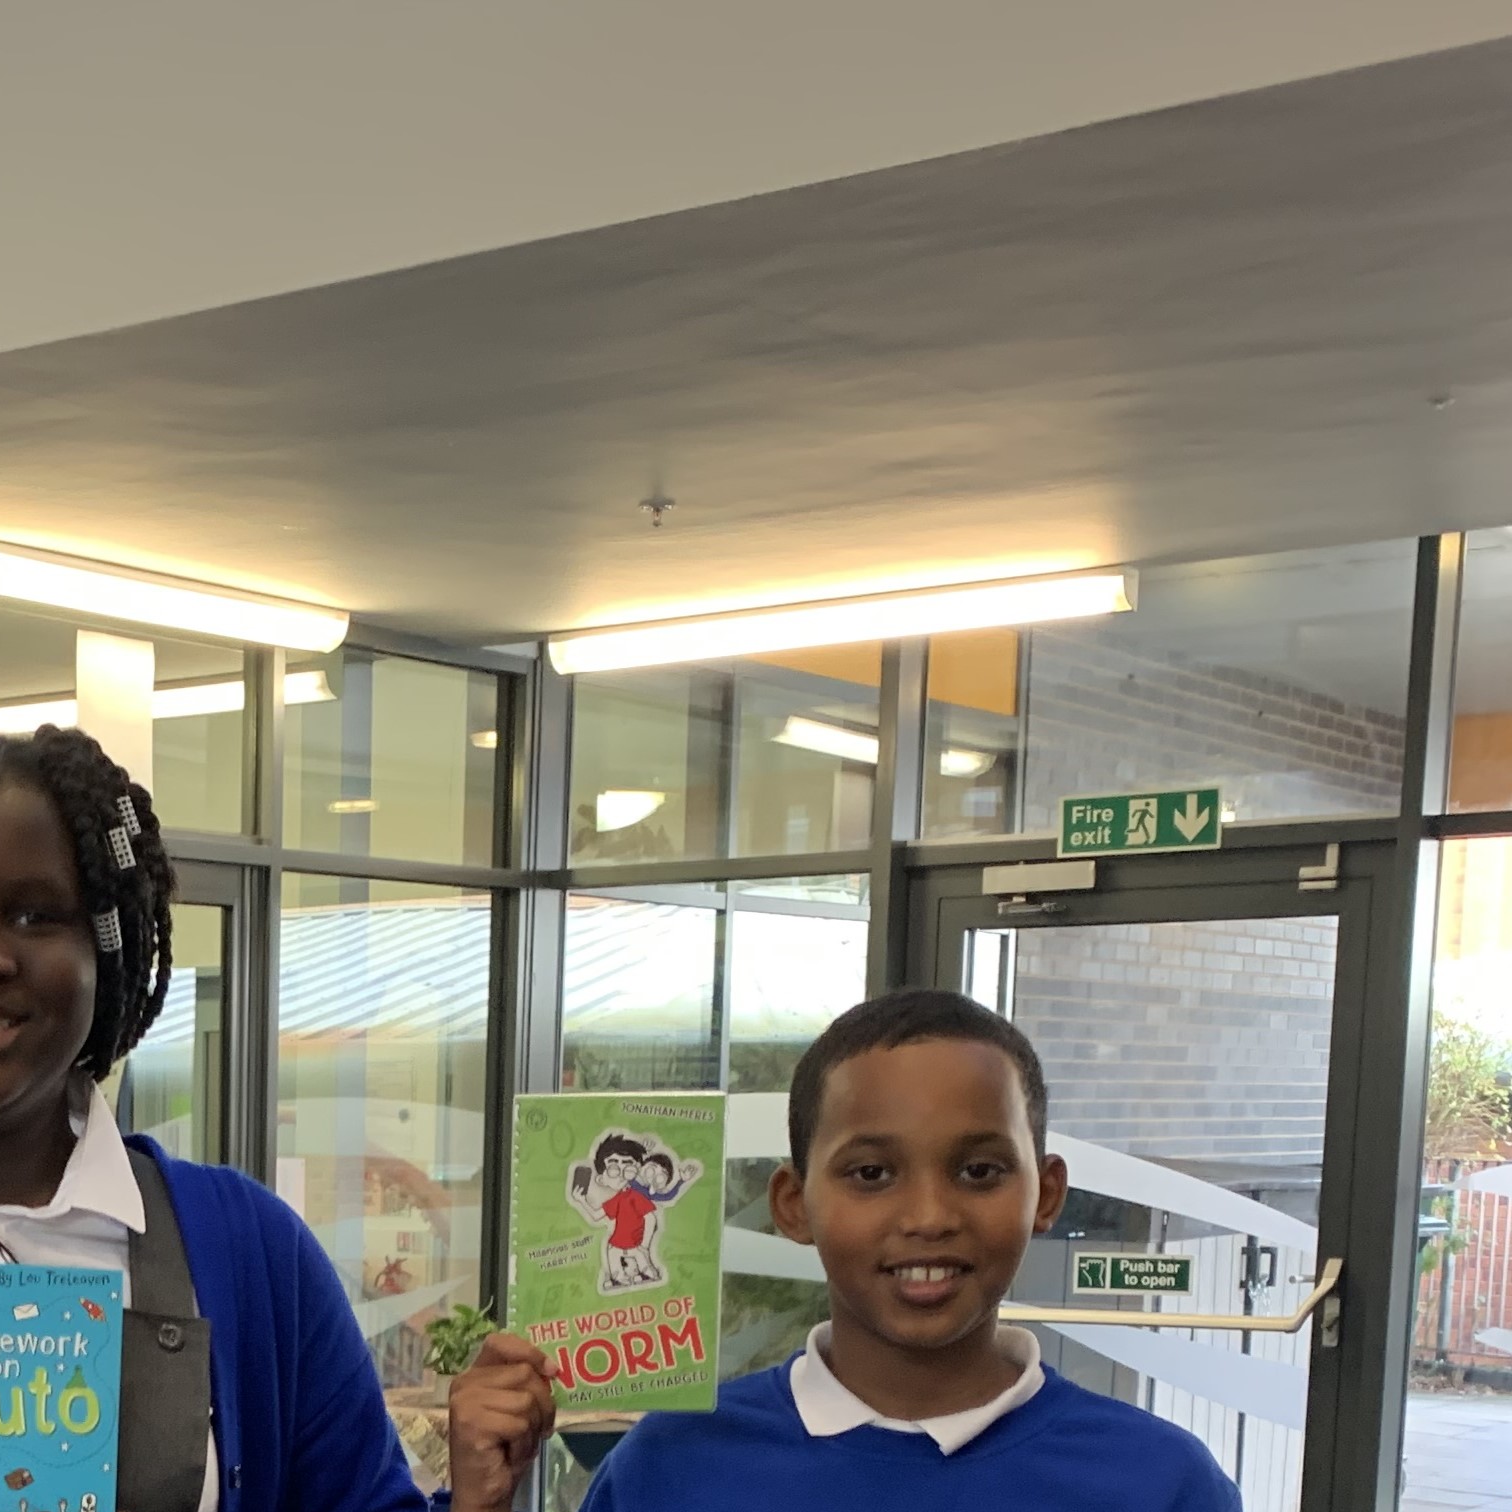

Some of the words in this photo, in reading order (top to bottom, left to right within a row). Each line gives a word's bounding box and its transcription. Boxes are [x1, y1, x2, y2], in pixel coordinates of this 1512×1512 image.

[1071, 805, 1114, 824] Fire
[1070, 826, 1112, 846] exit
[622, 1103, 676, 1116] JONATHAN
[680, 1109, 714, 1120] MERES
[1120, 1260, 1154, 1273] Push
[1157, 1262, 1181, 1273] bar
[19, 1272, 41, 1286] Lou
[46, 1270, 111, 1286] Treleaven
[1124, 1274, 1138, 1286] to
[1141, 1275, 1176, 1288] open
[529, 1320, 568, 1345] THE
[578, 1304, 656, 1334] WORLD
[664, 1296, 695, 1317] OF
[550, 1317, 705, 1392] NORM
[569, 1393, 592, 1403] MAY
[598, 1386, 624, 1399] STILL
[631, 1382, 644, 1392] BE
[650, 1372, 708, 1389] CHARGED
